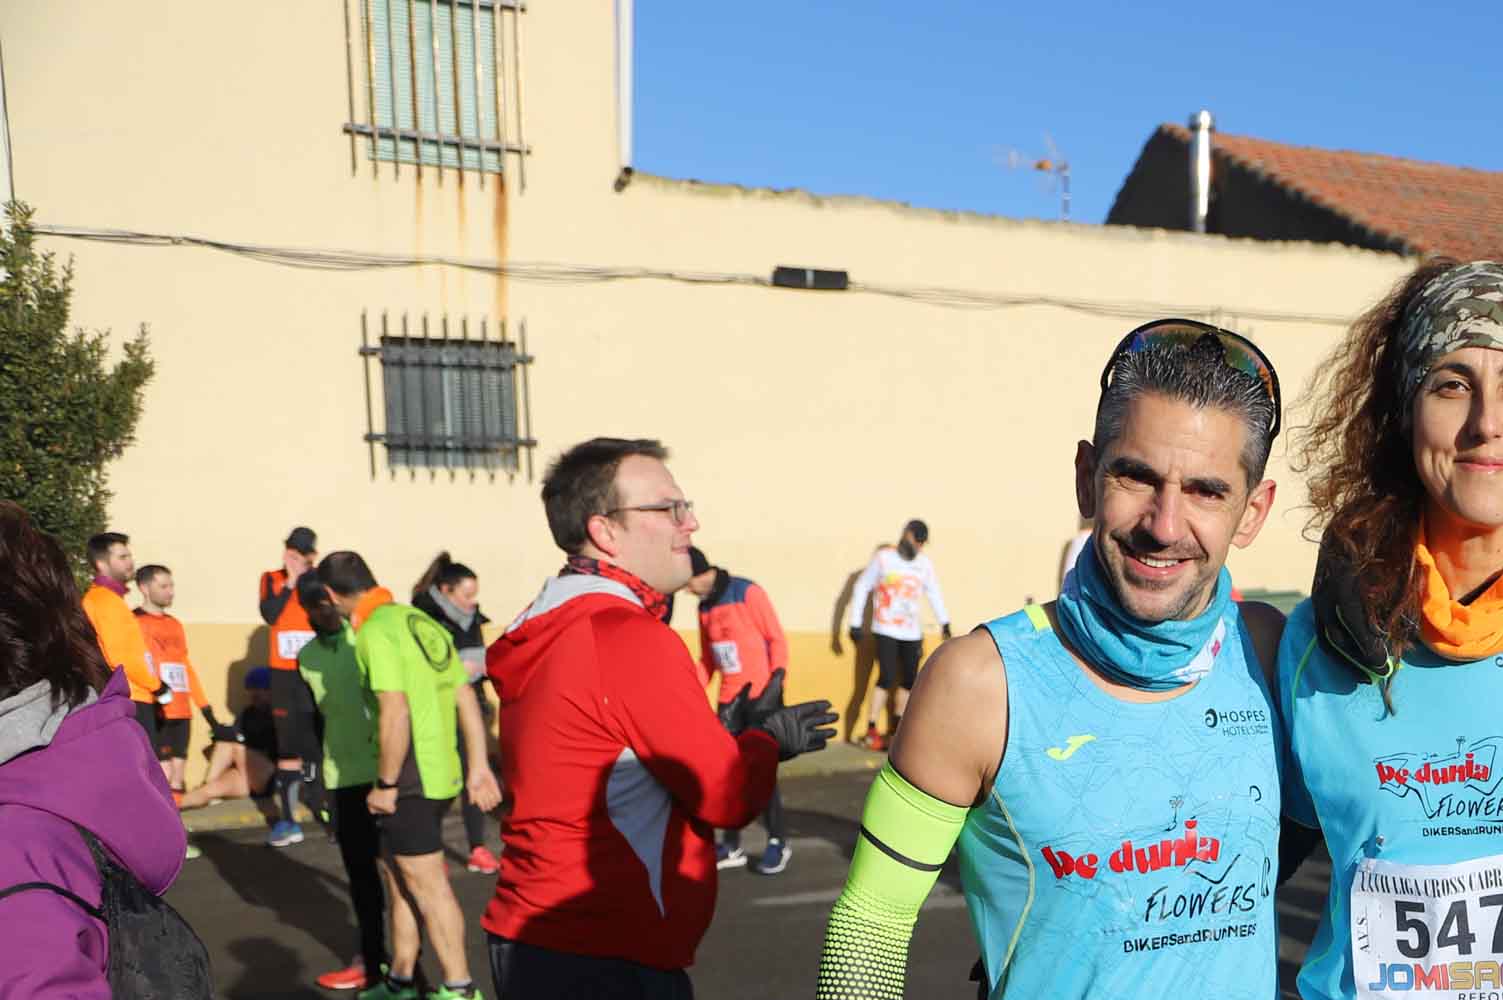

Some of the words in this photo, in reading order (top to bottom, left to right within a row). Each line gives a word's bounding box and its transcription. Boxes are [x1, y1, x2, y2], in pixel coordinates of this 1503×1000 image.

[1218, 709, 1266, 724] HOSPES
[1040, 845, 1099, 881] be
[1424, 875, 1466, 898] CROSS
[1144, 882, 1257, 923] FLOWERS
[1123, 922, 1258, 953] BIKERSandRUNNERS
